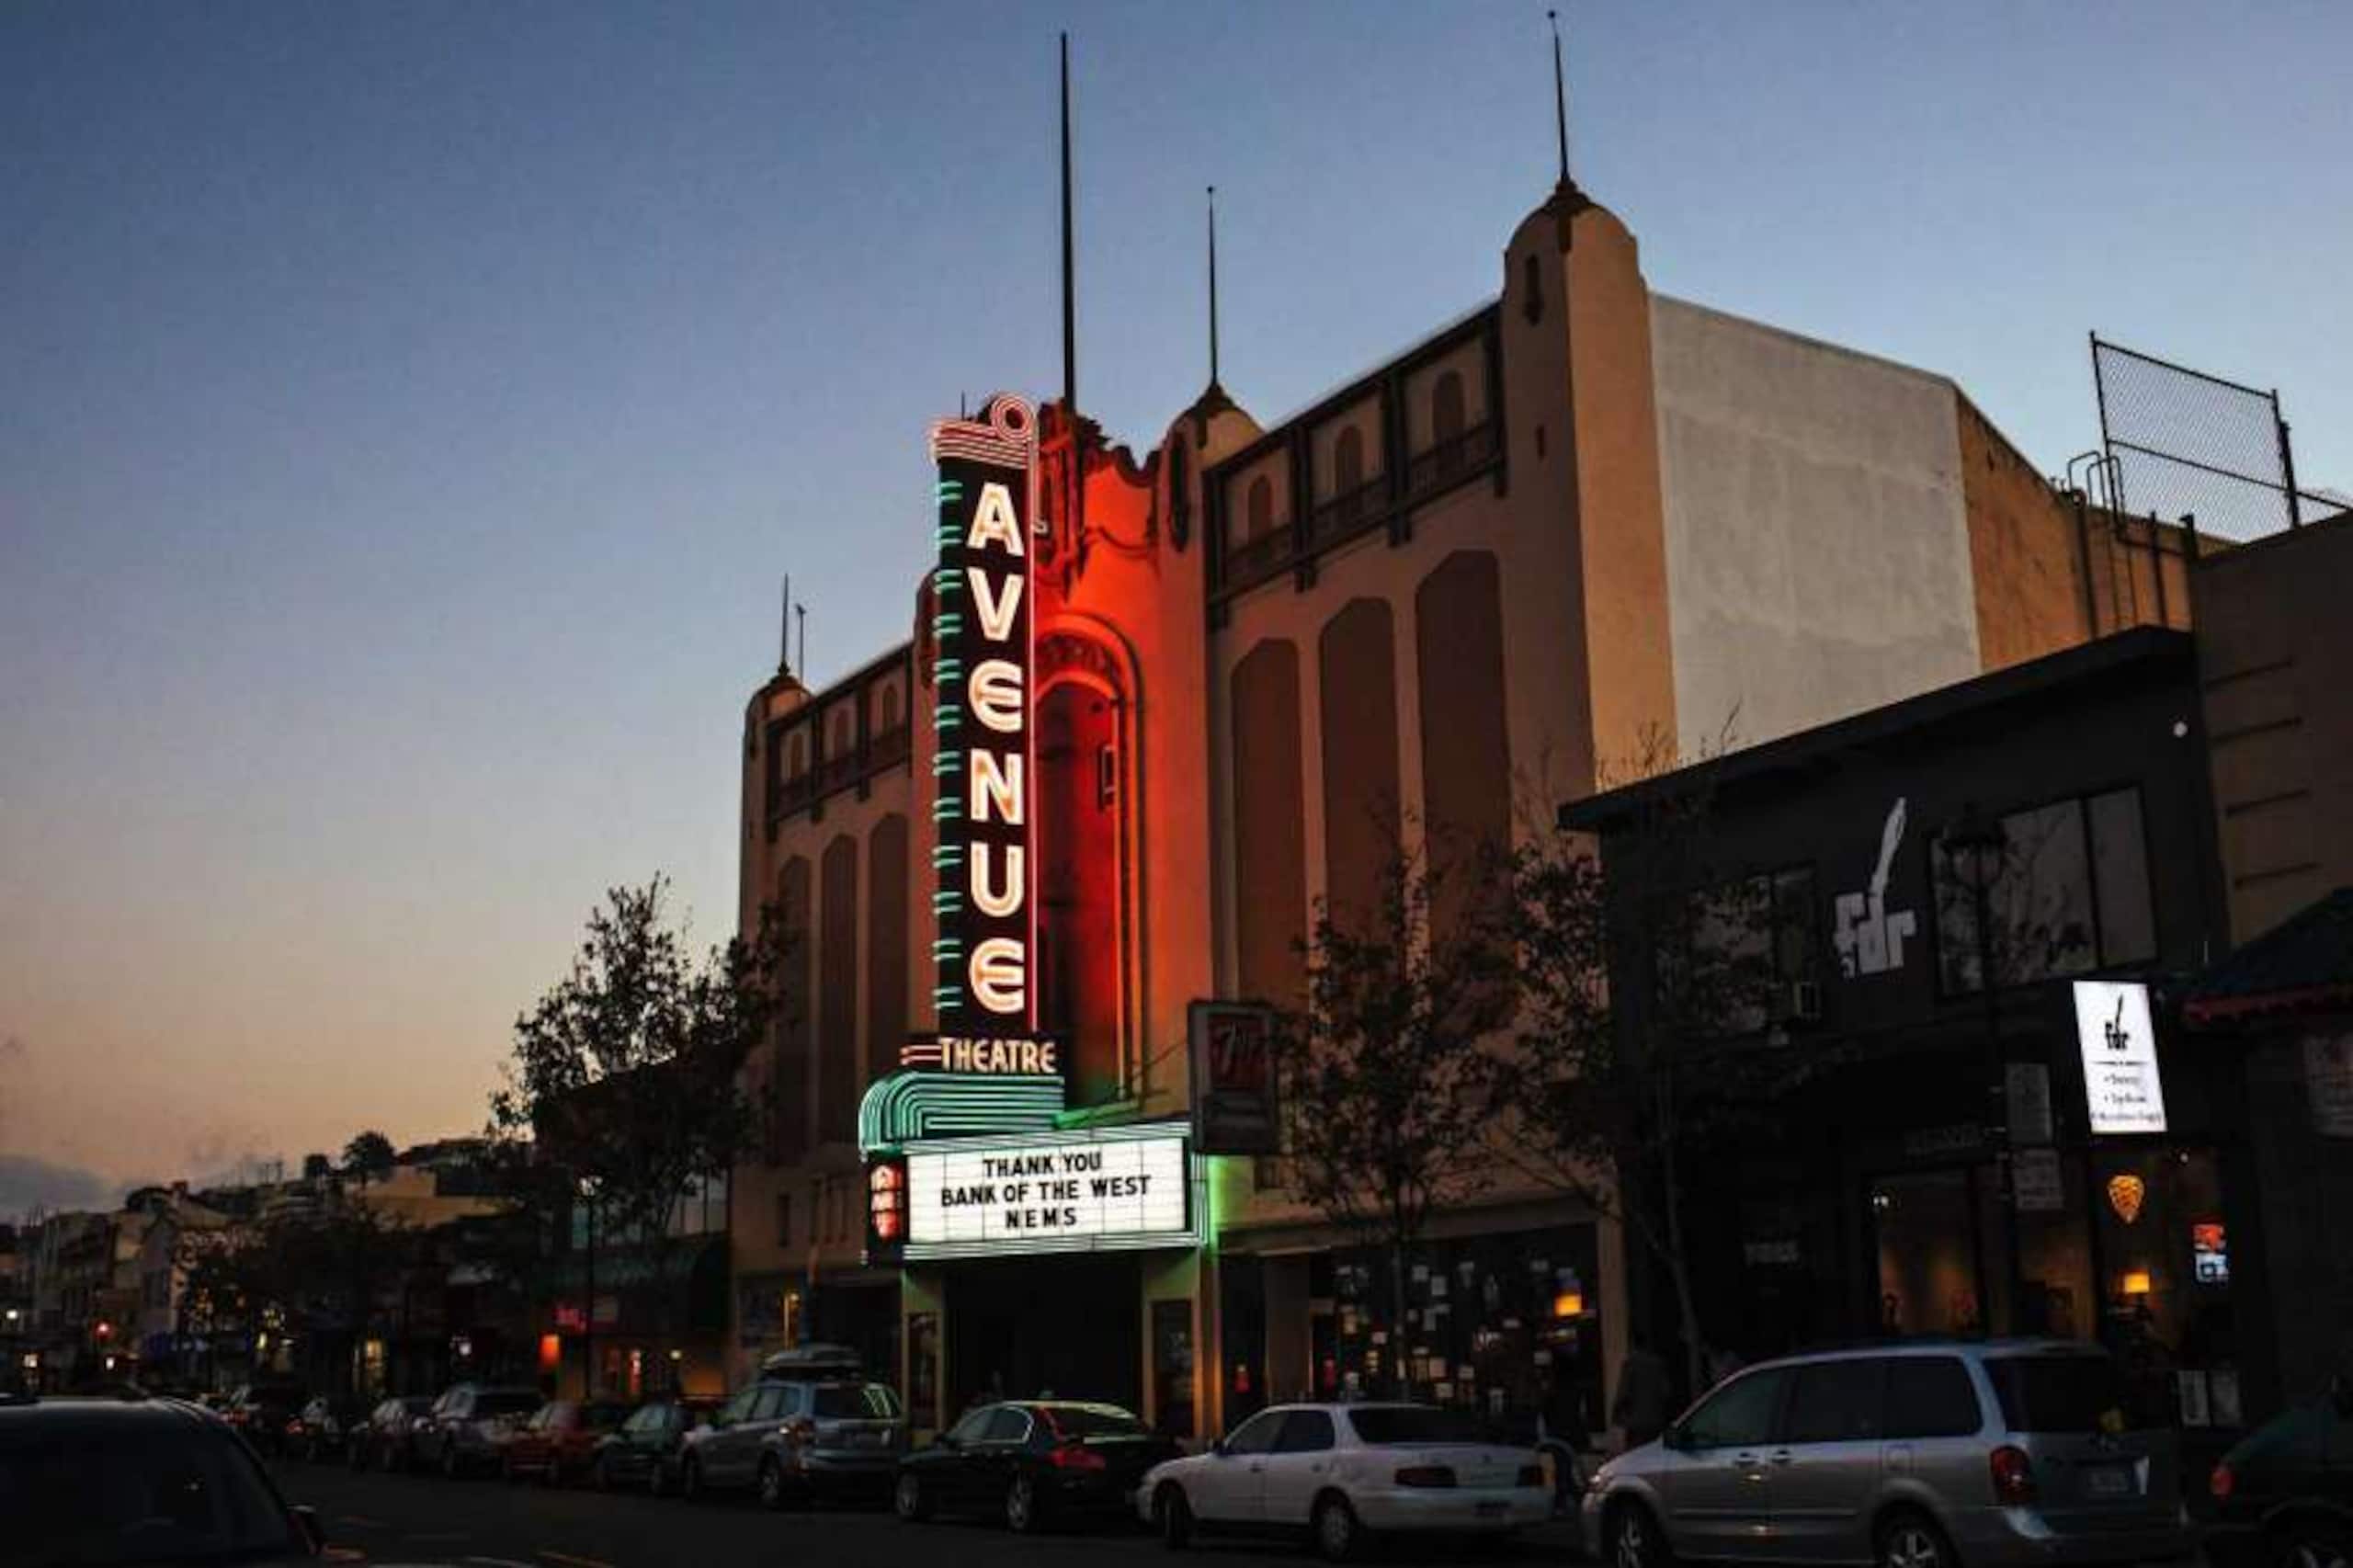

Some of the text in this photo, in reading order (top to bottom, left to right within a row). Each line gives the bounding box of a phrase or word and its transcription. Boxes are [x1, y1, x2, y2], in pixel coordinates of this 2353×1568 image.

[968, 480, 1024, 1013] AVENUE
[939, 1037, 1058, 1074] THEATRE
[983, 1152, 1101, 1177] THANK YOU
[941, 1175, 1151, 1207] BANK OF THE WEST
[1006, 1208, 1077, 1229] NEMS
